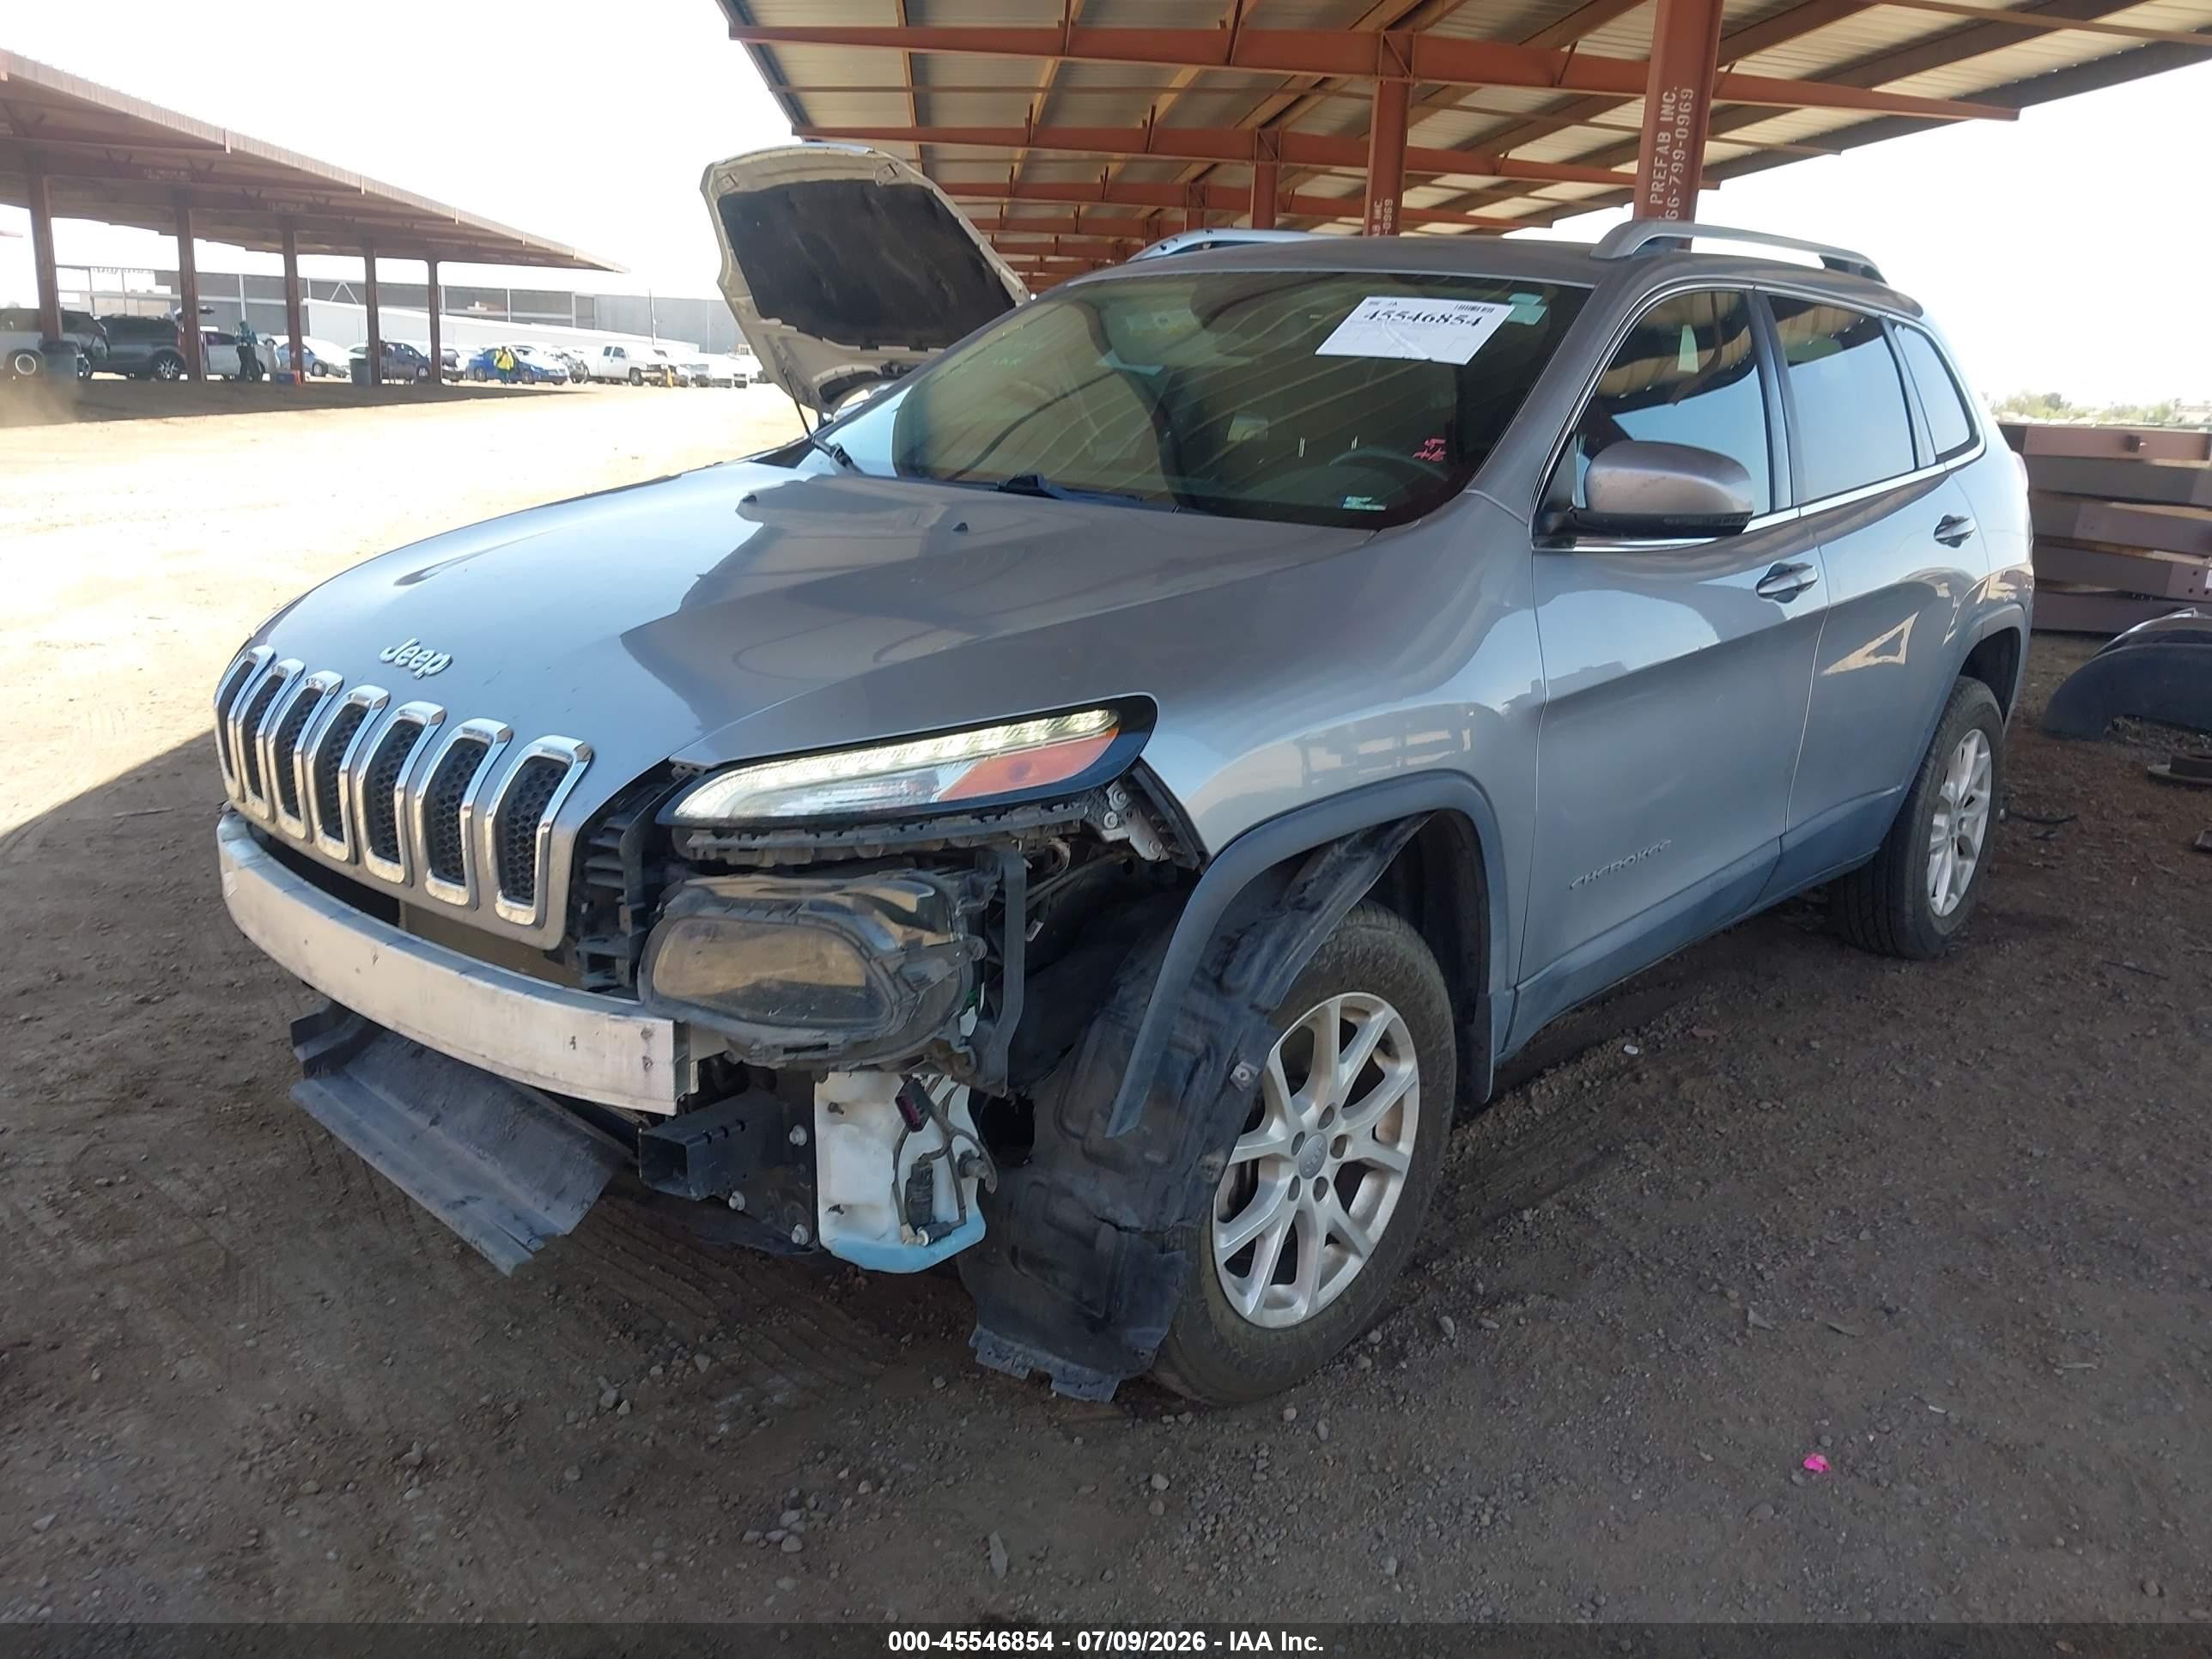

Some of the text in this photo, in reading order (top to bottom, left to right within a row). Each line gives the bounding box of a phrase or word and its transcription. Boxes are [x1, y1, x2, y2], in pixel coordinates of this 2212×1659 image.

[1650, 87, 1678, 204] PREFAB INC.
[1364, 309, 1484, 327] 45546854
[379, 637, 453, 680] Jeep
